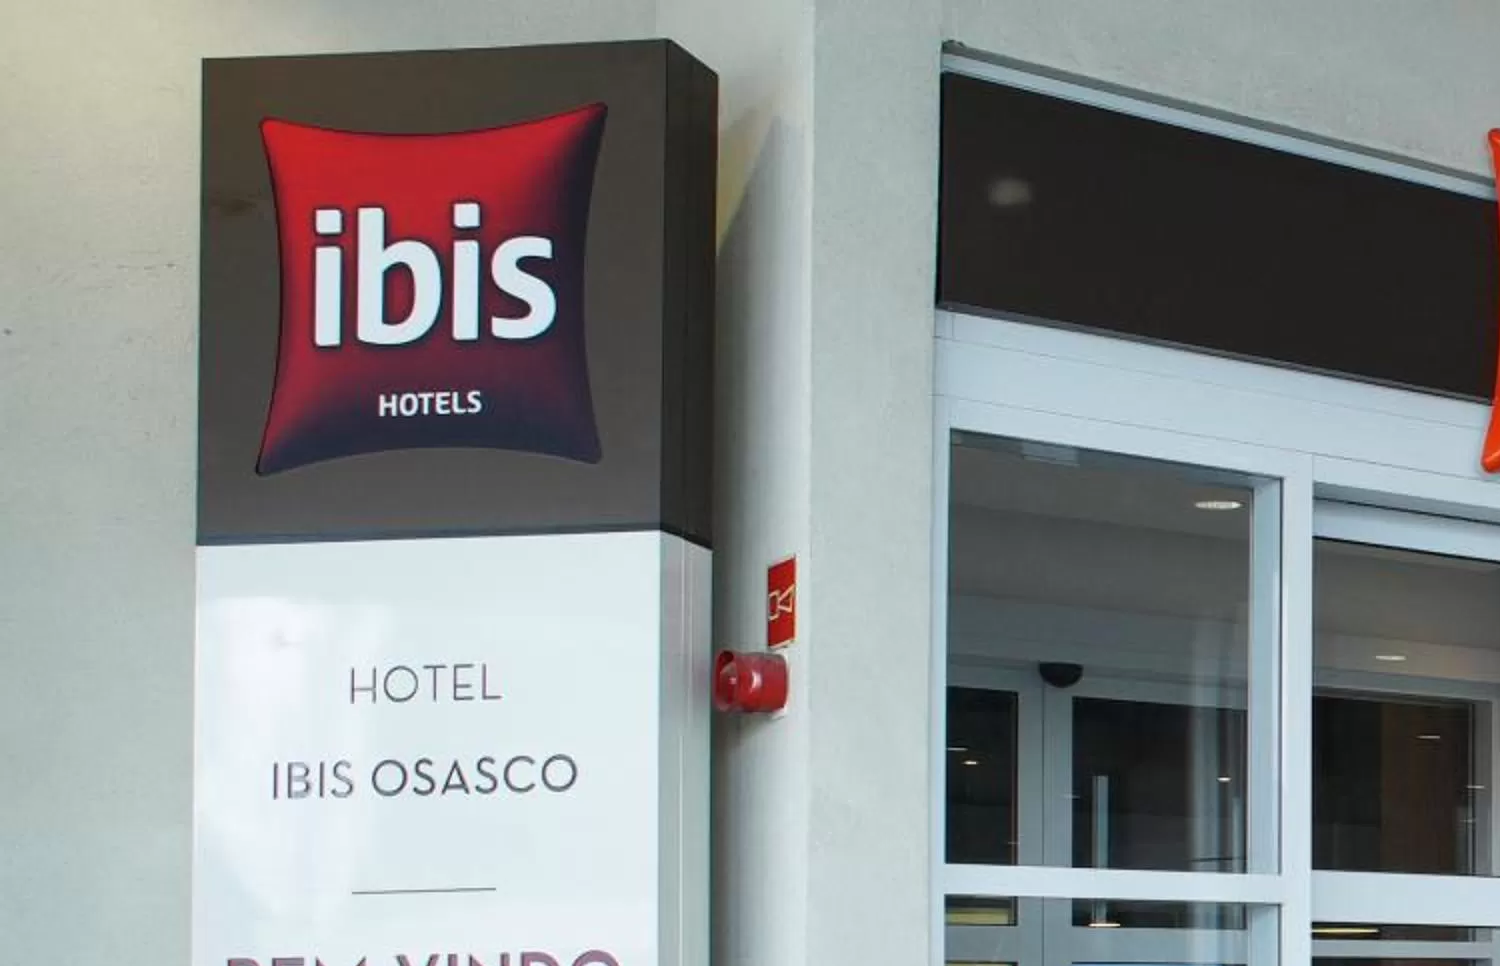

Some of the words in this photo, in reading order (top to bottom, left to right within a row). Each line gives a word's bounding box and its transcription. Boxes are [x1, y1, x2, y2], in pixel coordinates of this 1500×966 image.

[314, 202, 557, 347] ibis
[377, 390, 483, 418] HOTELS
[349, 664, 503, 704] HOTEL
[271, 759, 355, 800] IBIS
[370, 753, 578, 797] OSASCO
